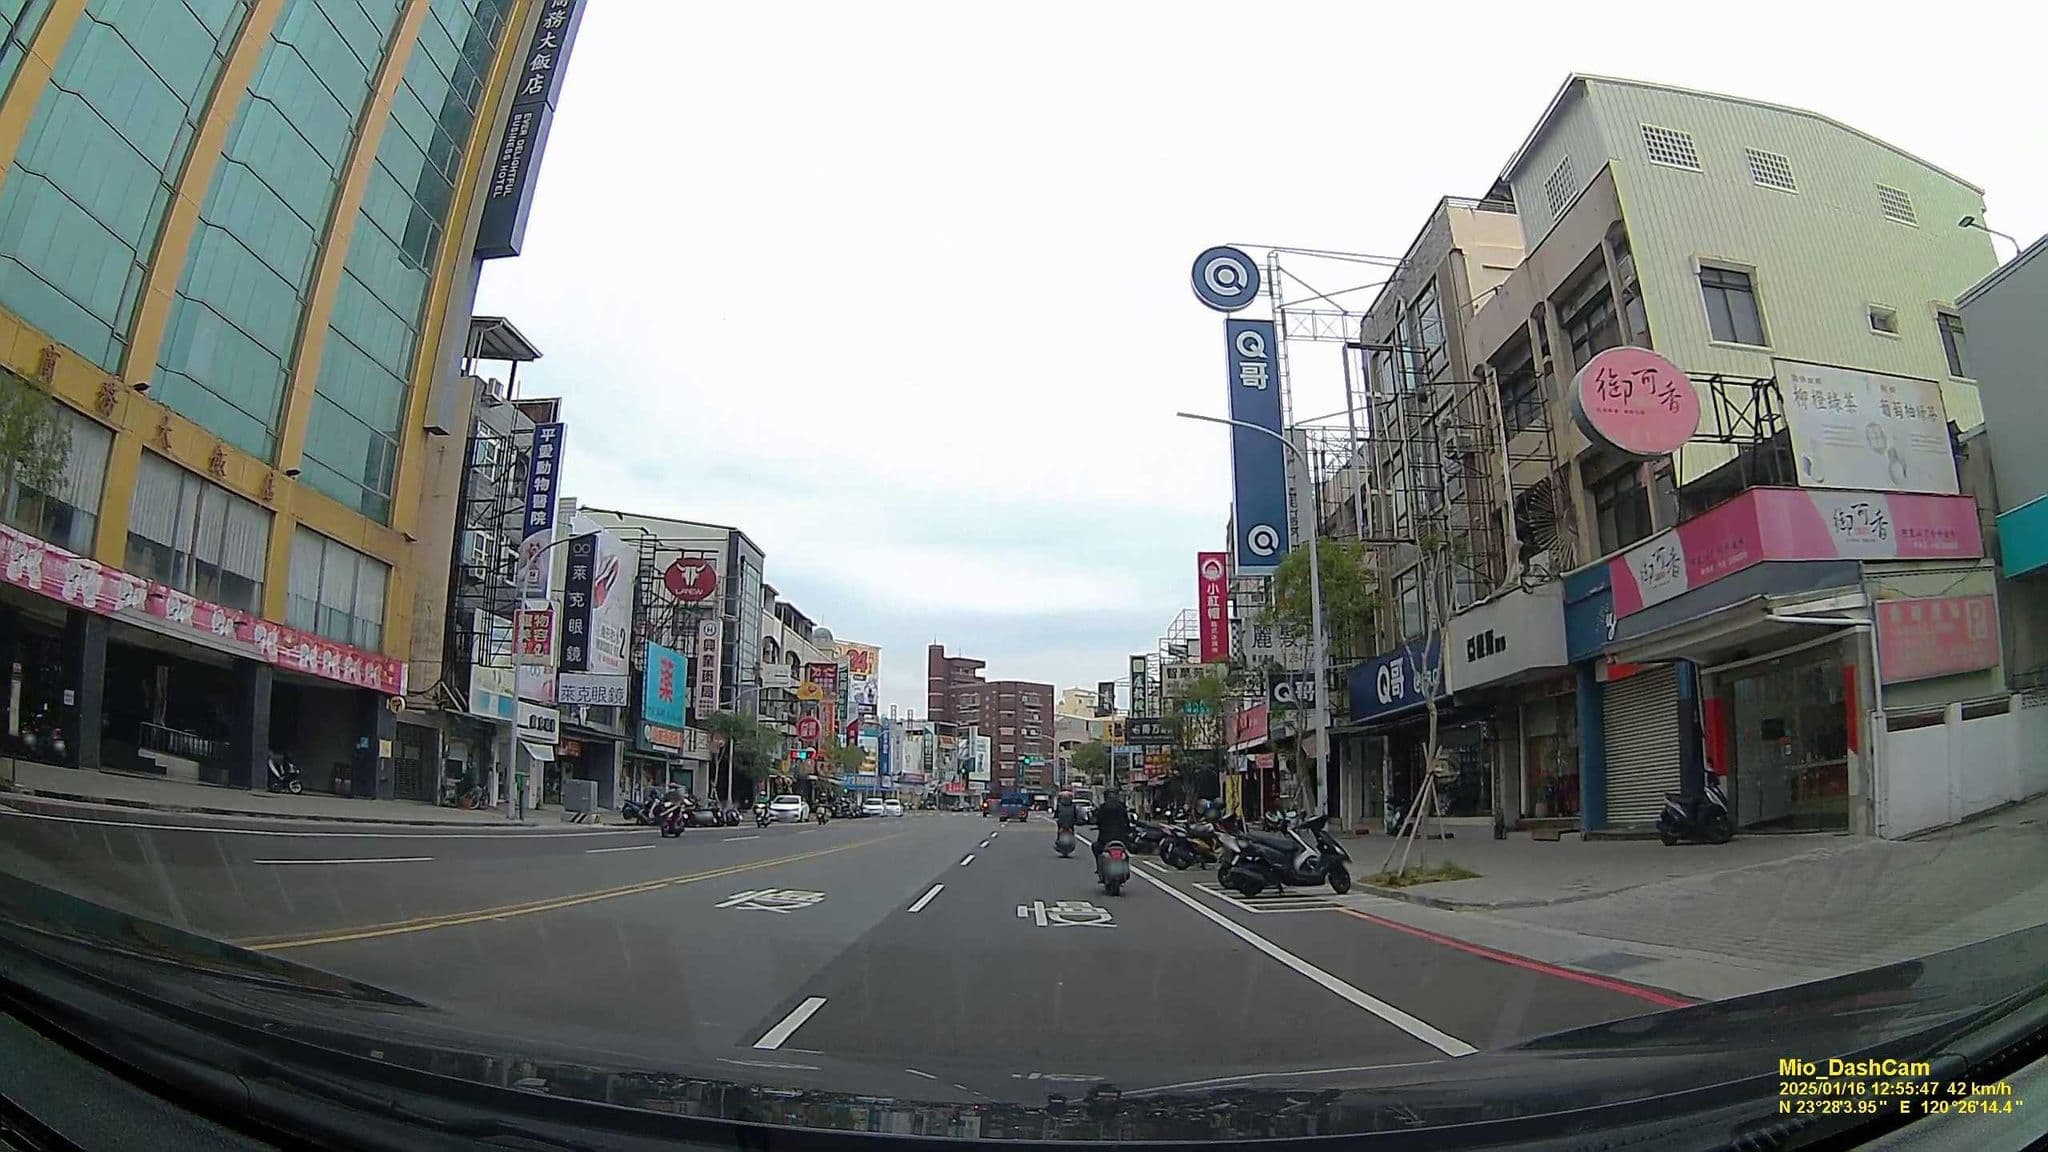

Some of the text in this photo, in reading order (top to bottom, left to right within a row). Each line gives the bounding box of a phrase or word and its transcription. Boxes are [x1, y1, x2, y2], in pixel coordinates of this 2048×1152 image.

[492, 112, 523, 199] BUSINESS HOTEL
[502, 112, 533, 197] EVER DELIGHTFUL
[1236, 330, 1269, 390] Q哥
[1595, 367, 1682, 414] 御可香
[1833, 503, 1889, 541] 御可香
[566, 562, 588, 663] 萊克眼鏡
[560, 684, 626, 706] 萊克眼鏡
[1376, 657, 1405, 705] Q哥
